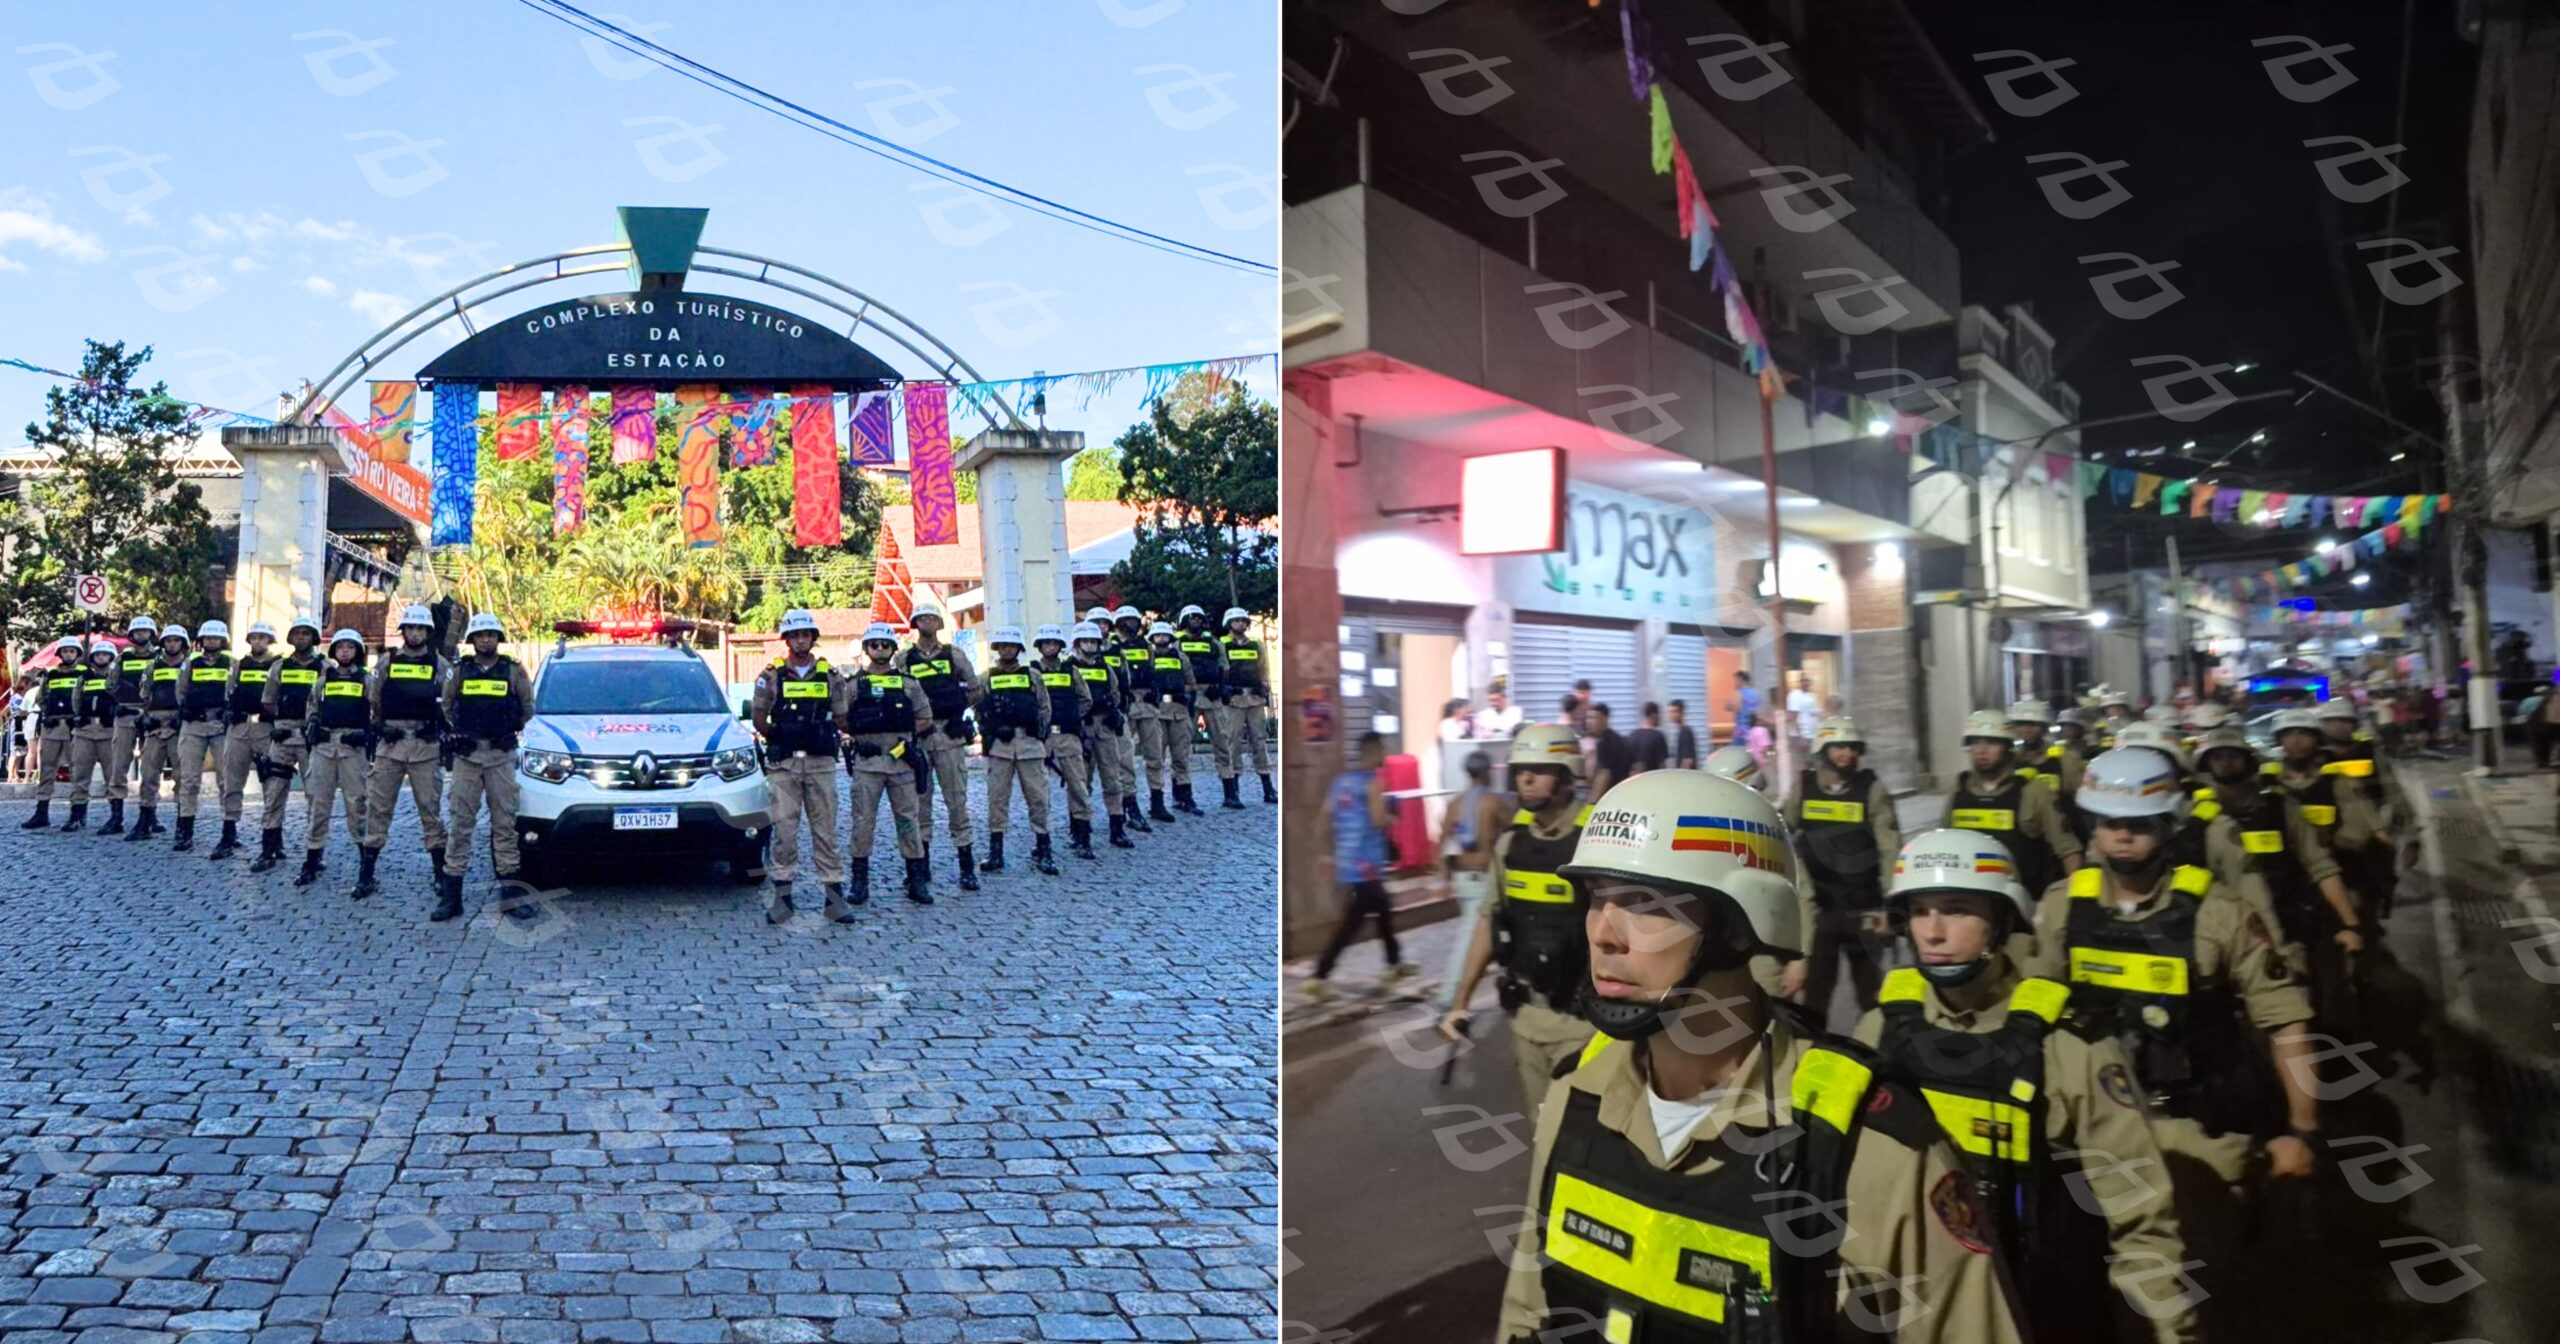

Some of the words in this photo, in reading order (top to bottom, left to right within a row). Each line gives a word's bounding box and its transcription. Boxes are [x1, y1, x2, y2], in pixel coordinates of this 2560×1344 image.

[527, 301, 654, 333] COMPLEXO
[676, 302, 803, 338] TURÍSTICO
[650, 328, 681, 341] DA
[608, 350, 725, 368] ESTAÇÃO
[1591, 809, 1648, 828] POLÍCIA
